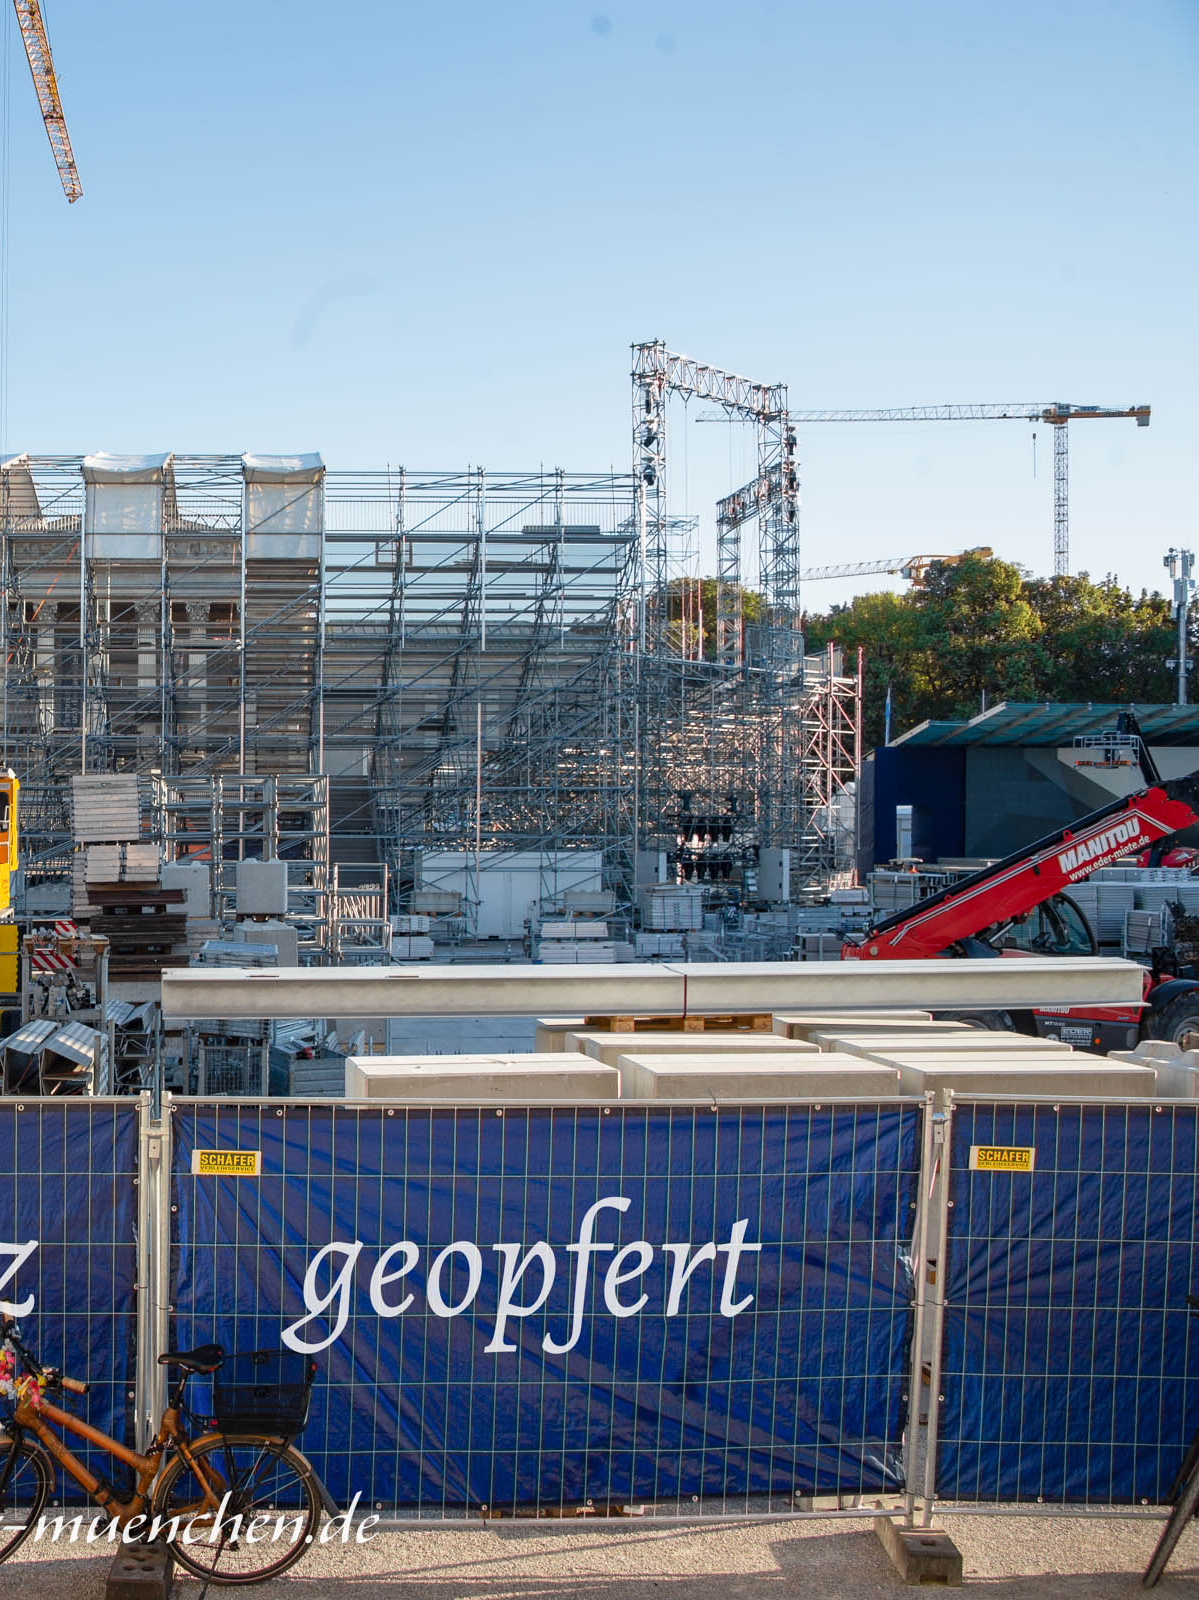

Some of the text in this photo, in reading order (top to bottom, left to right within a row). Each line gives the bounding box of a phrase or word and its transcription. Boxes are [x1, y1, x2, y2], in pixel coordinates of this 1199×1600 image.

[1058, 817, 1140, 873] MANITOU
[1069, 835, 1150, 881] www.eder-miete.de
[282, 1197, 763, 1354] geopfert
